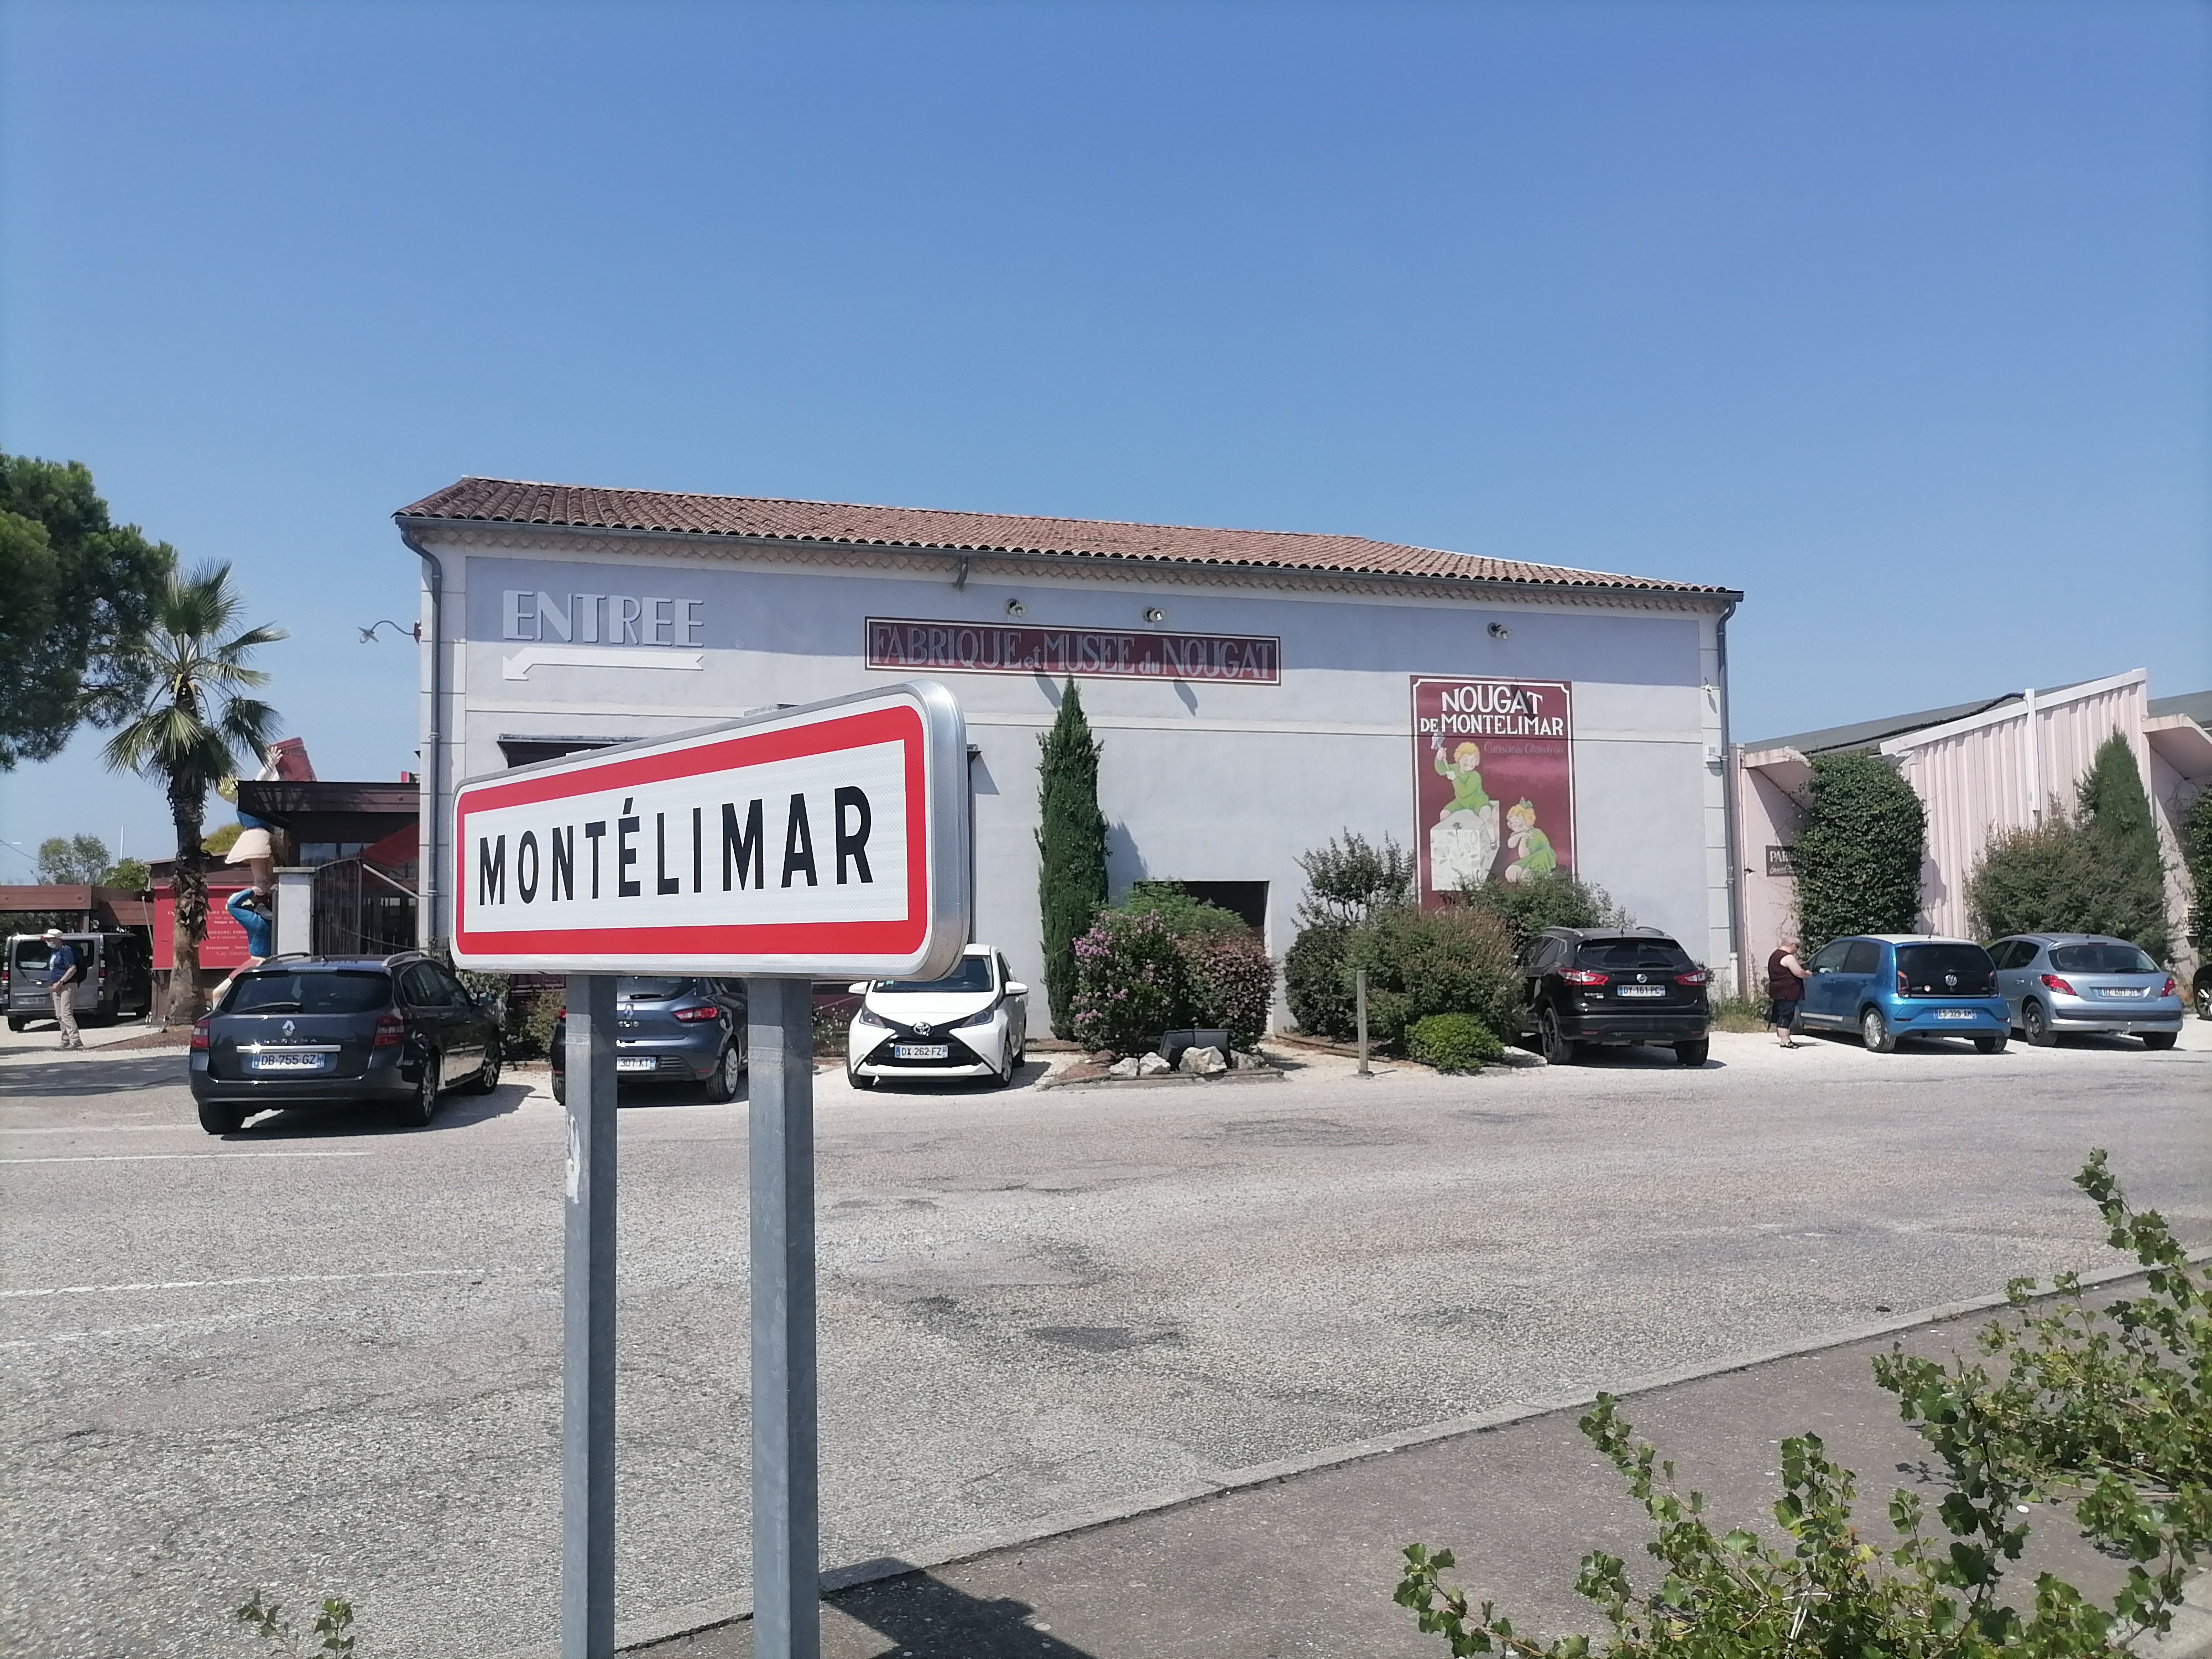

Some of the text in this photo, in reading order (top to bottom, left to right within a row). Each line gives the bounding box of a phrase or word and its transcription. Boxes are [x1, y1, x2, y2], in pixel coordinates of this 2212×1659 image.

[503, 590, 704, 647] ENTREE
[872, 625, 1273, 680] FABRIQUE et MUSEE du NOUGAT
[1420, 713, 1564, 736] DE MONTELIMAR
[1442, 685, 1543, 714] NOUGAT
[479, 785, 874, 906] MONTÉLIMAR
